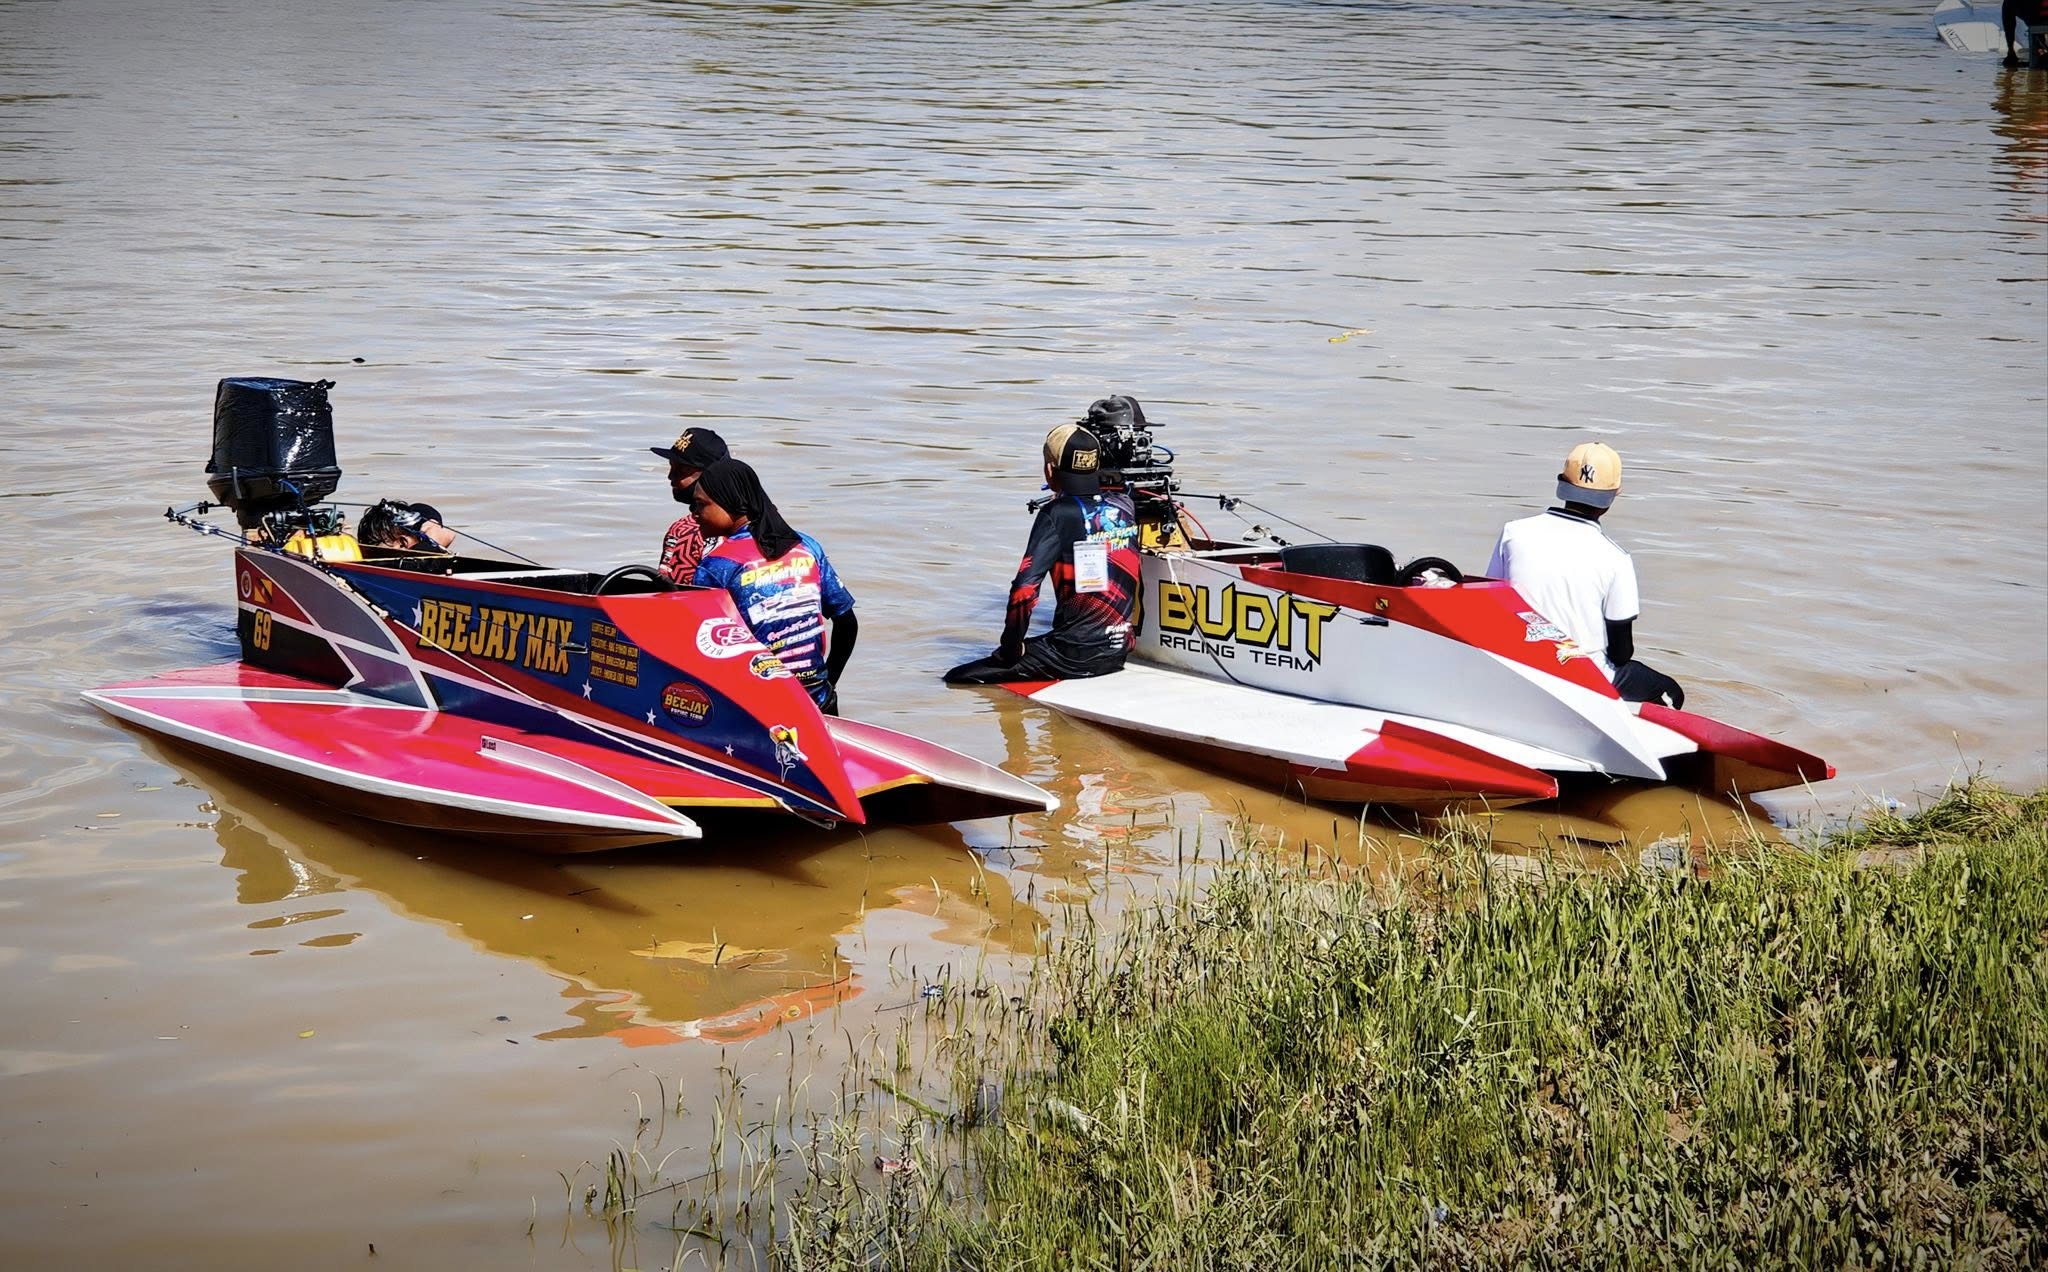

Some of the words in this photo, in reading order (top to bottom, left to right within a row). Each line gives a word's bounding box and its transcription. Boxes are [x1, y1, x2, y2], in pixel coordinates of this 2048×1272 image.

[254, 609, 272, 651] 69
[1158, 580, 1341, 665] BUDIT
[1160, 633, 1235, 659] RACING
[1249, 650, 1313, 672] TEAM
[664, 694, 710, 716] BEEJAY
